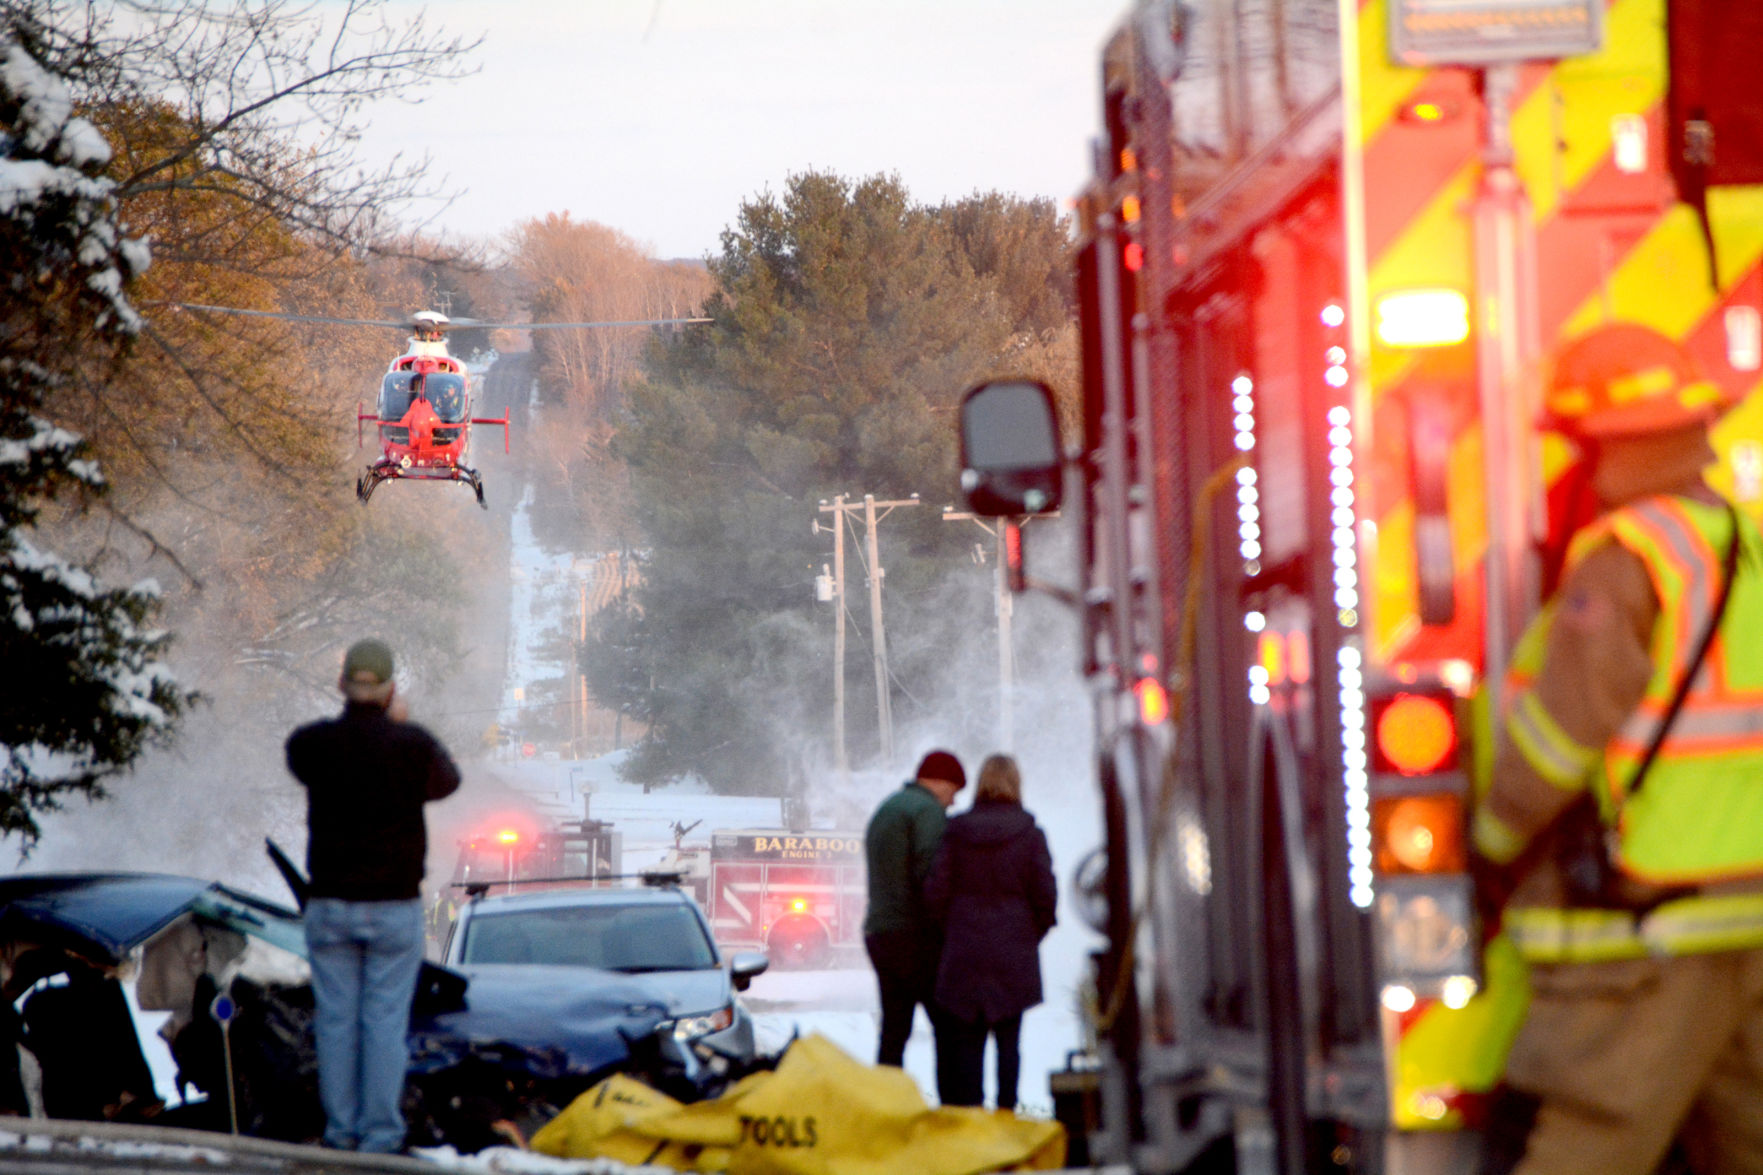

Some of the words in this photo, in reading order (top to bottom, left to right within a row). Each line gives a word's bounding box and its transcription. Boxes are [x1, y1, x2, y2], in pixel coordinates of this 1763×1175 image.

[754, 837, 860, 853] BARABOO
[782, 850, 820, 858] ENGINE
[740, 1115, 818, 1147] TOOLS
